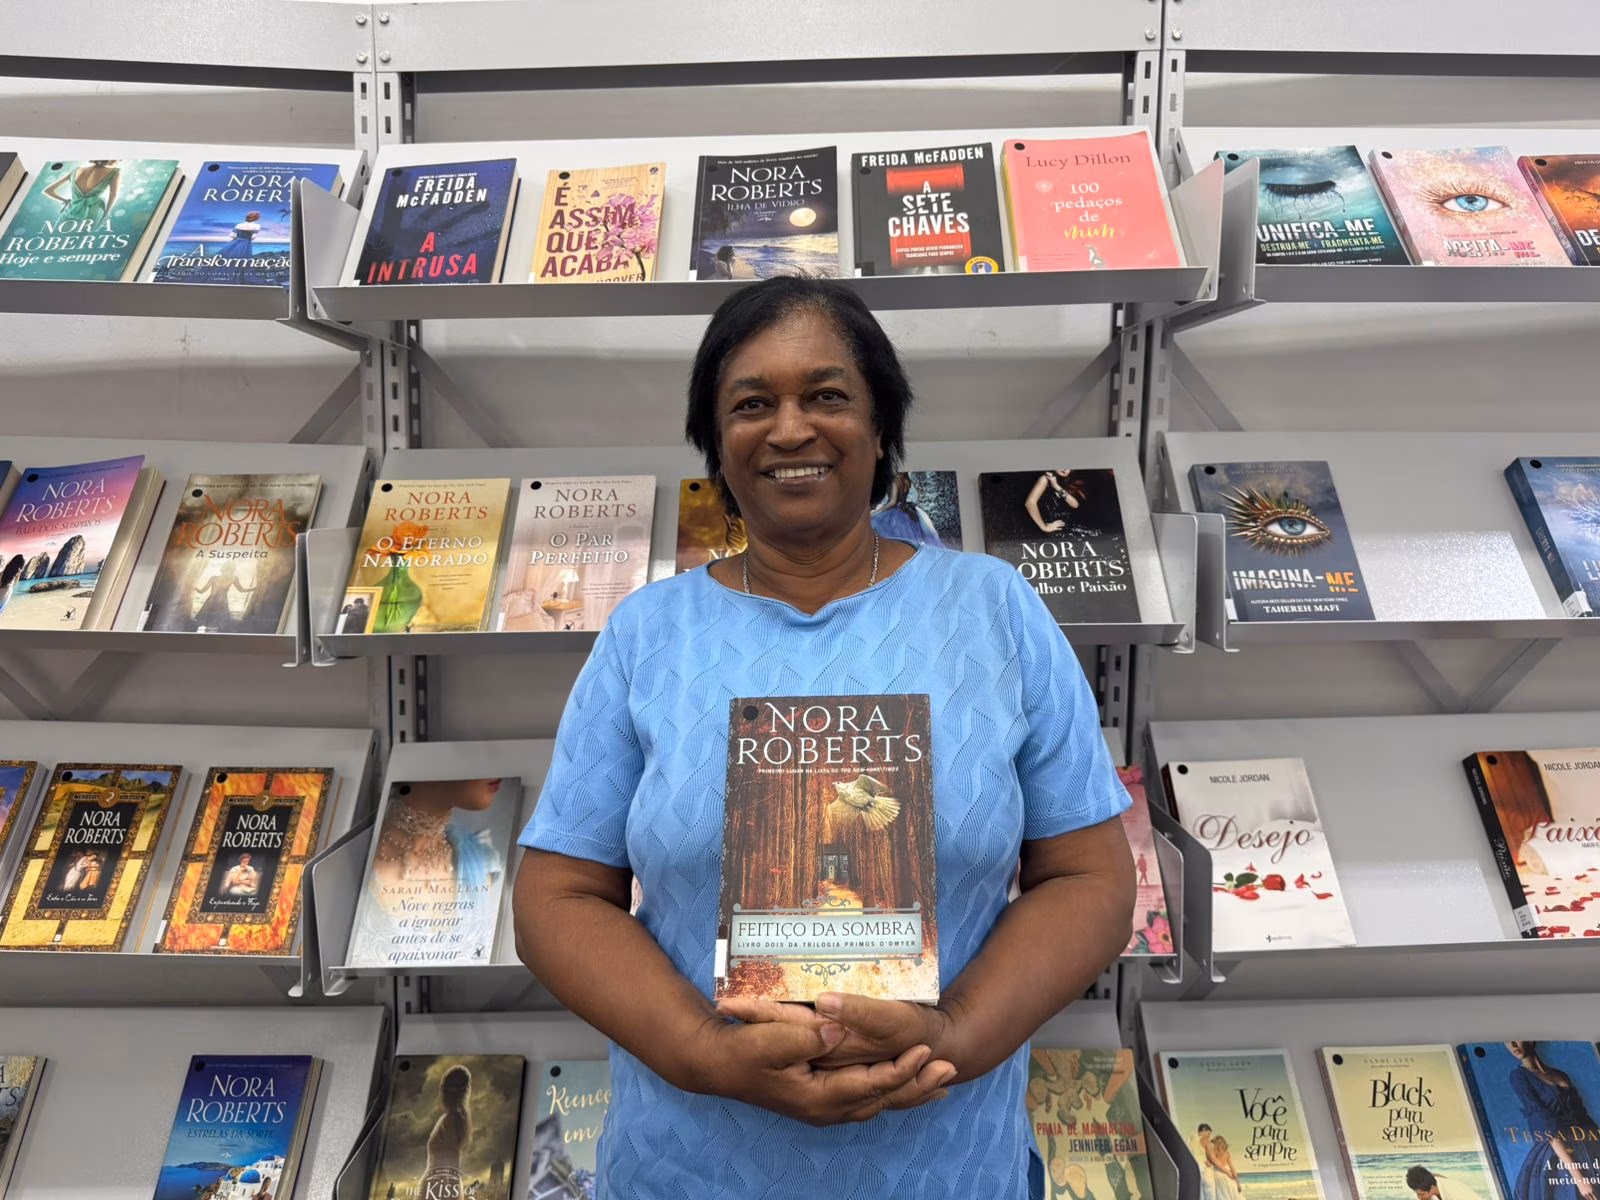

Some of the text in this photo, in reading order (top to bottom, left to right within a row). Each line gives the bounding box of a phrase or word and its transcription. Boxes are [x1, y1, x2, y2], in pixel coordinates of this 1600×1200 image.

[861, 146, 984, 168] FREIDA McFADDEN
[1025, 153, 1131, 170] Lucy Dillon
[730, 164, 806, 184] NORA
[414, 176, 475, 193] FREIDA
[711, 179, 823, 201] ROBERTS
[922, 180, 931, 194] A
[1069, 181, 1100, 194] 100
[203, 187, 293, 202] ROBER
[396, 188, 488, 208] McFADDEN
[554, 182, 571, 206] É
[727, 199, 805, 211] ILHA DE VIDRO
[902, 193, 954, 215] SETE
[1050, 196, 1123, 213] pedaços
[549, 203, 639, 229] ASSIM
[1078, 210, 1100, 222] de
[40, 217, 114, 234] NORA
[888, 212, 970, 238] CHAVES
[6, 234, 130, 251] ROBERTS
[419, 231, 435, 253] A
[546, 227, 602, 253] QUE
[44, 255, 54, 264] e
[58, 251, 121, 265] sempre
[540, 253, 630, 278] ACABA
[366, 252, 478, 285] INTRUSA
[41, 478, 105, 500] NORA
[554, 488, 620, 502] NORA
[407, 491, 471, 505] NORA
[16, 495, 117, 522] ROBERTS
[203, 494, 287, 522] NORA
[384, 506, 488, 522] ROBERTS
[533, 503, 637, 519] ROBERTS
[376, 535, 483, 550] O ETERNO
[550, 533, 614, 548] O PAR
[195, 550, 269, 561] A Suspeita
[529, 550, 629, 565] PERFEITO
[1020, 540, 1098, 560] NORA
[361, 552, 488, 568] NAMORADO
[1017, 559, 1126, 581] OBERTS
[1067, 584, 1076, 594] e
[1080, 581, 1127, 594] Paixão
[1263, 604, 1340, 613] TAHEREH MAFI
[764, 702, 891, 733] NORA
[736, 733, 923, 765] ROBERTS
[1544, 762, 1572, 772] NICOLE
[1209, 773, 1270, 784] NICOLE JORDAN
[80, 810, 121, 827] NORA
[236, 814, 277, 830] NORA
[64, 828, 127, 845] ROBERTS
[222, 832, 283, 848] ROBERTS
[1193, 814, 1314, 864] Desejo
[381, 885, 423, 895] SARAH
[392, 896, 475, 915] Nove regras
[398, 915, 463, 932] a ignorar
[737, 921, 916, 939] FEITIÇO DA SOMBRA
[391, 932, 464, 945] antes de se
[844, 940, 875, 948] PRIMOS
[387, 948, 462, 965] apaixonar
[209, 1074, 275, 1097] NORA
[1368, 1071, 1435, 1108] Black
[186, 1097, 287, 1123] ROBERTS
[1235, 1088, 1288, 1126] Você
[1388, 1107, 1424, 1127] para
[1036, 1122, 1063, 1136] PRAIA
[1252, 1124, 1288, 1145] para
[1382, 1123, 1434, 1143] sempre
[1569, 1125, 1600, 1141] DA
[1068, 1138, 1138, 1152] JENNIFER EGAN
[1244, 1141, 1297, 1161] sempre
[1543, 1159, 1589, 1170] A dama
[405, 1186, 422, 1196] THE
